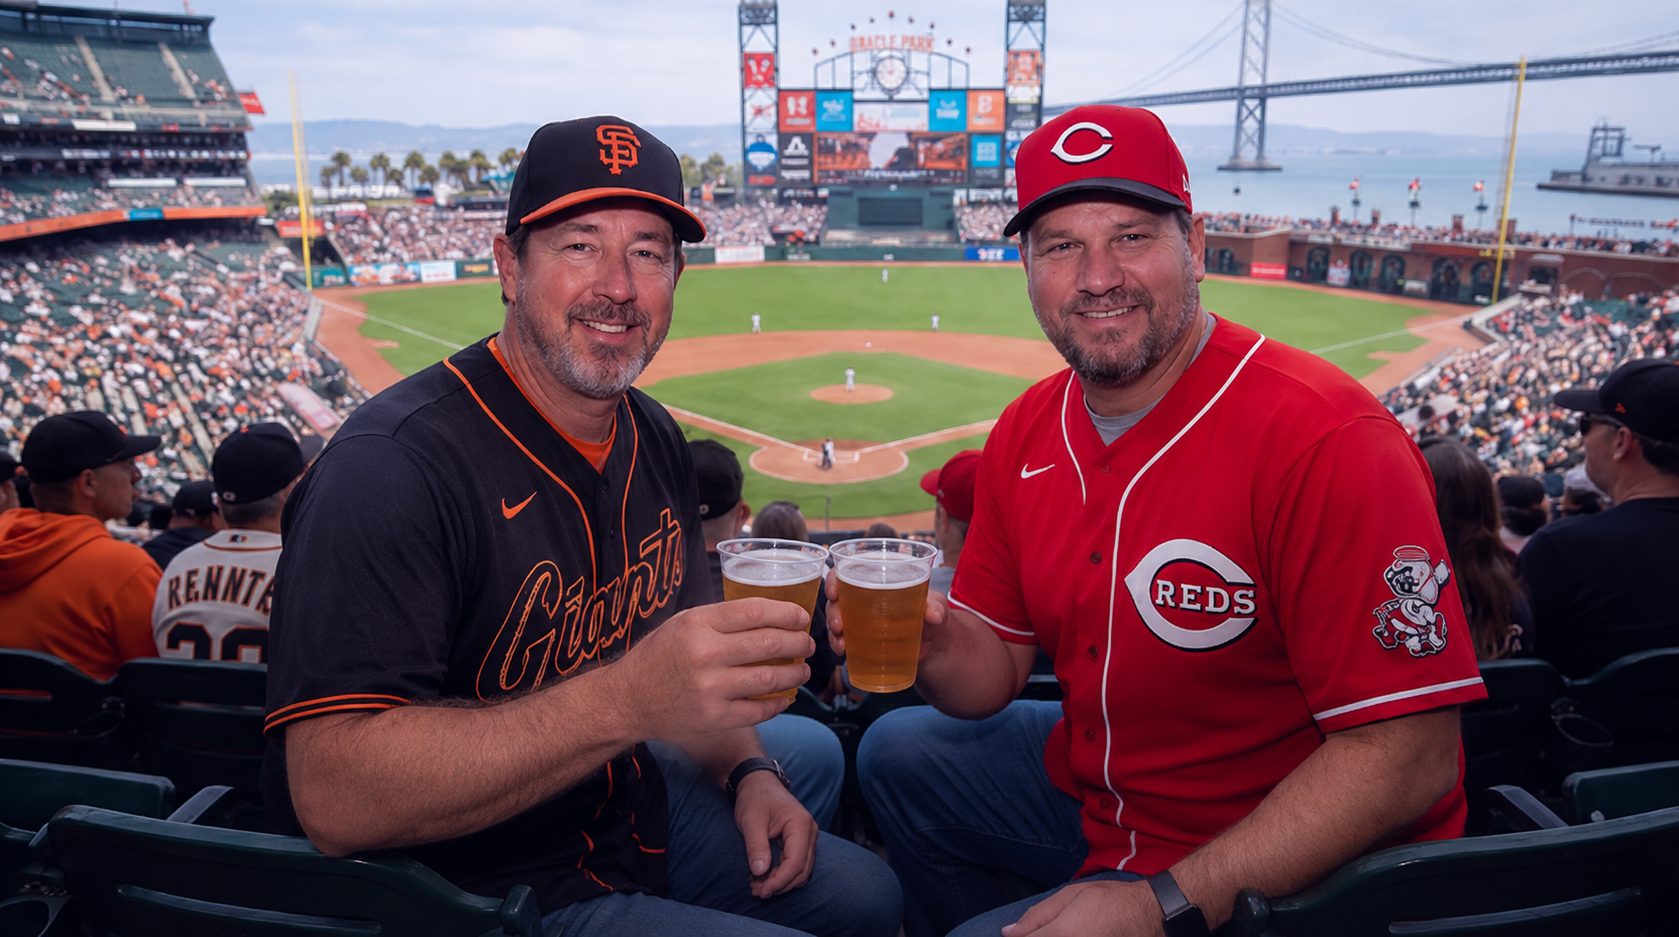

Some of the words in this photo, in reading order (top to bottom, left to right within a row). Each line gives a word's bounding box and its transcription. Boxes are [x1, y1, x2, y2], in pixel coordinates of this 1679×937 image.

[901, 35, 935, 53] PARK
[596, 124, 641, 175] SF
[1050, 121, 1114, 165] C
[476, 508, 683, 704] Giants
[1124, 538, 1259, 653] C
[1155, 579, 1257, 615] REDS
